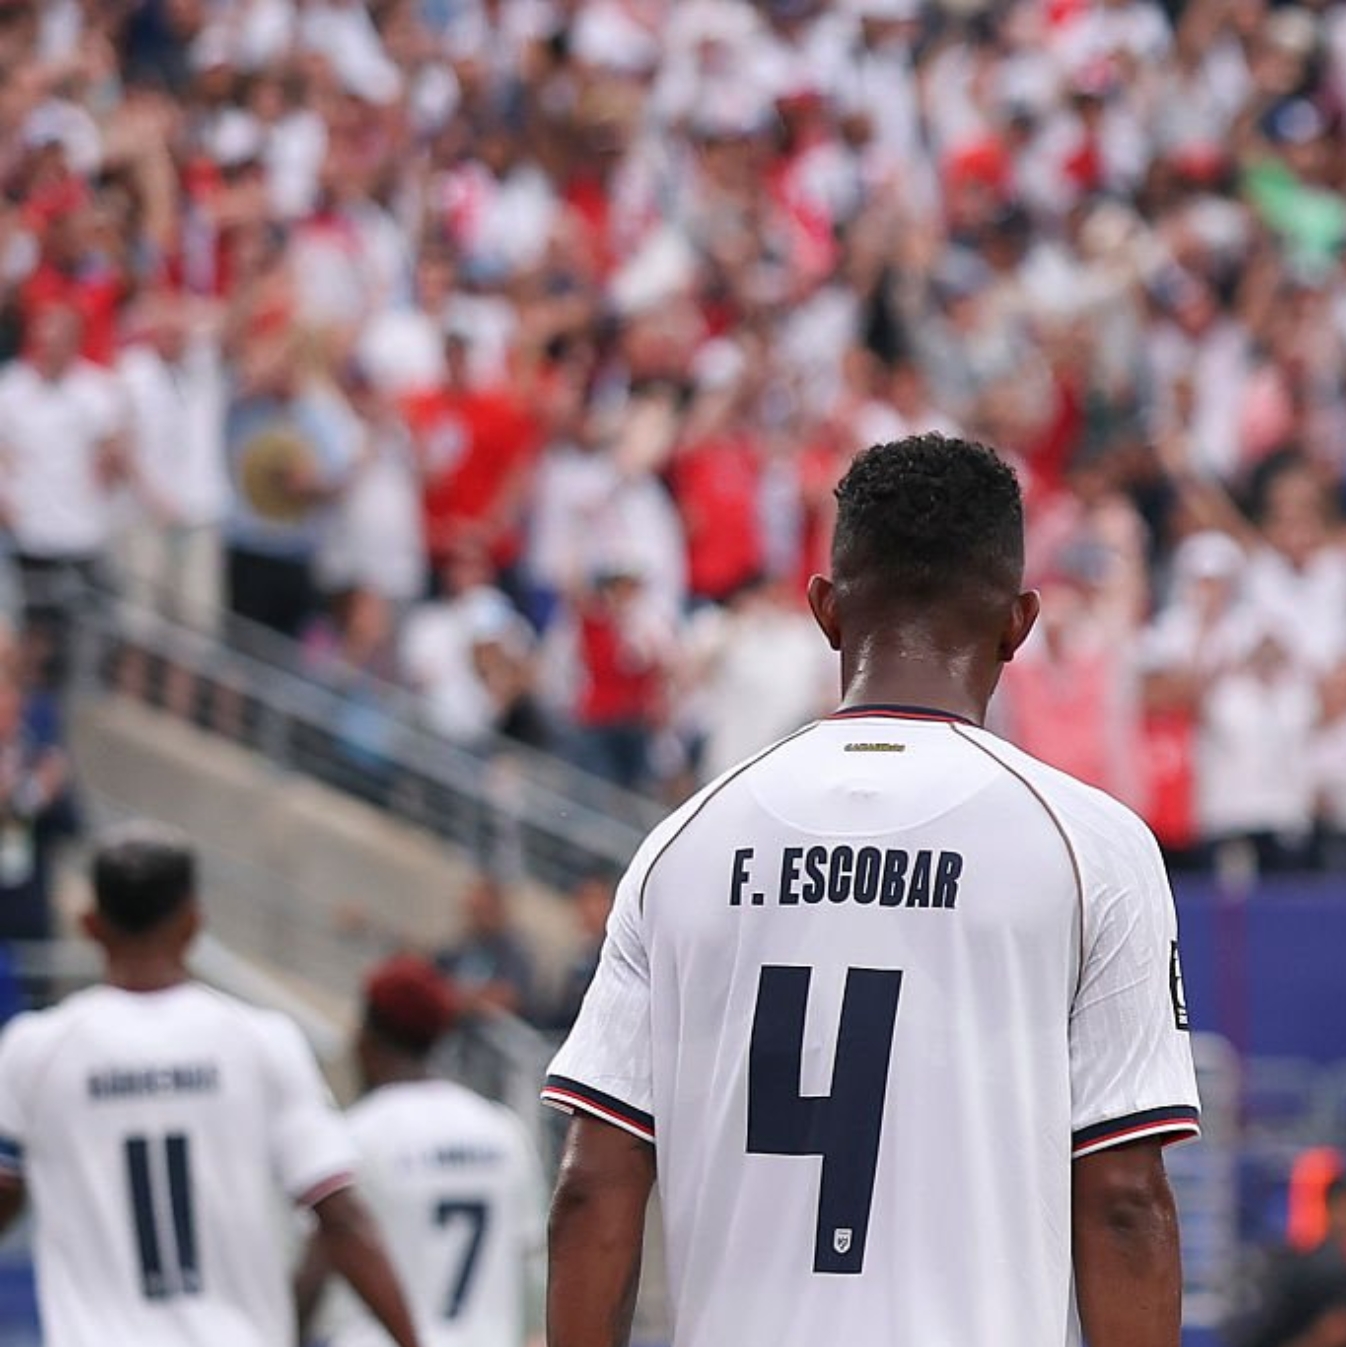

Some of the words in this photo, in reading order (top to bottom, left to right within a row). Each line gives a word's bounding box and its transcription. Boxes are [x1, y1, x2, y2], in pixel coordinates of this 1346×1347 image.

[729, 847, 765, 906] F.
[778, 845, 964, 909] ESCOBAR
[746, 964, 904, 1275] 4
[126, 1133, 202, 1298] 11
[435, 1198, 490, 1320] 7
